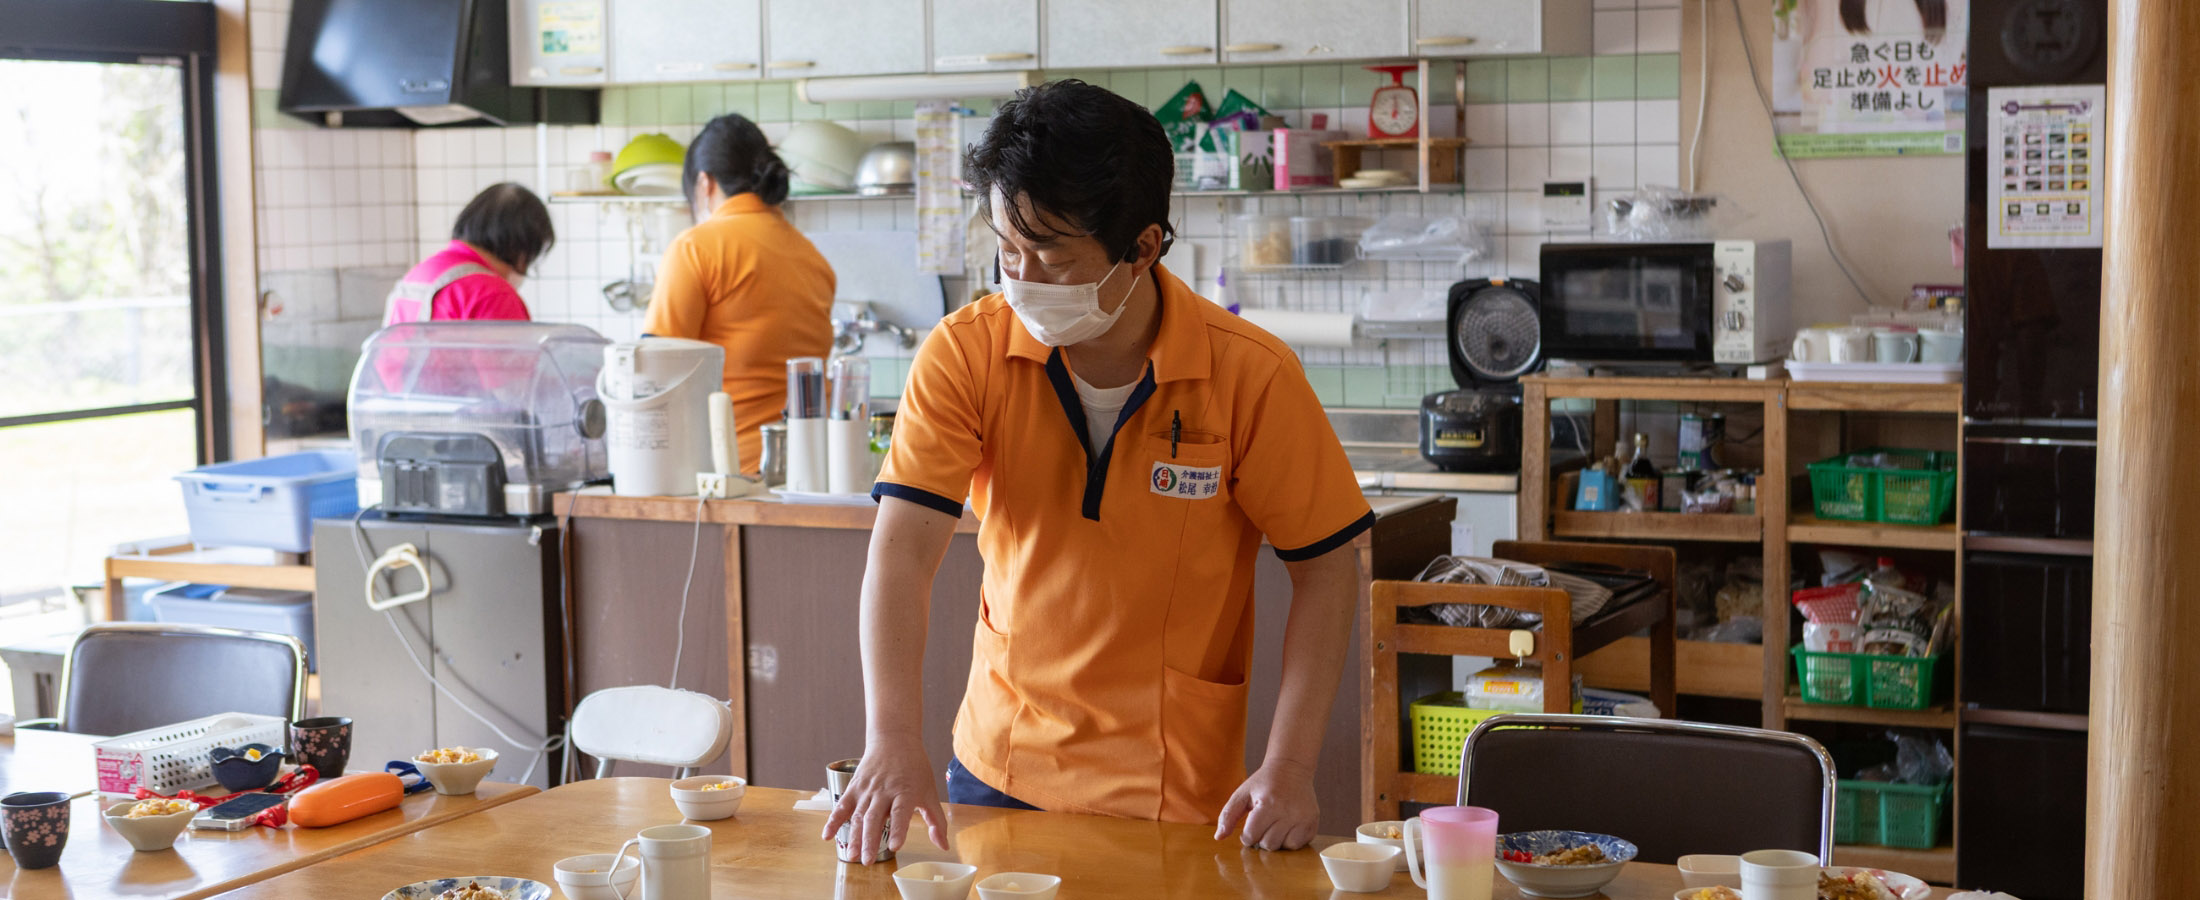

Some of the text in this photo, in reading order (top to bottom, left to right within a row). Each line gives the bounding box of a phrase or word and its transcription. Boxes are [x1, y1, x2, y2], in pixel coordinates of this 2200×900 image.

[1850, 41, 1935, 63] 急ぐ日も
[1813, 61, 1967, 89] 足止め火を止め
[1850, 90, 1935, 112] 準備よし
